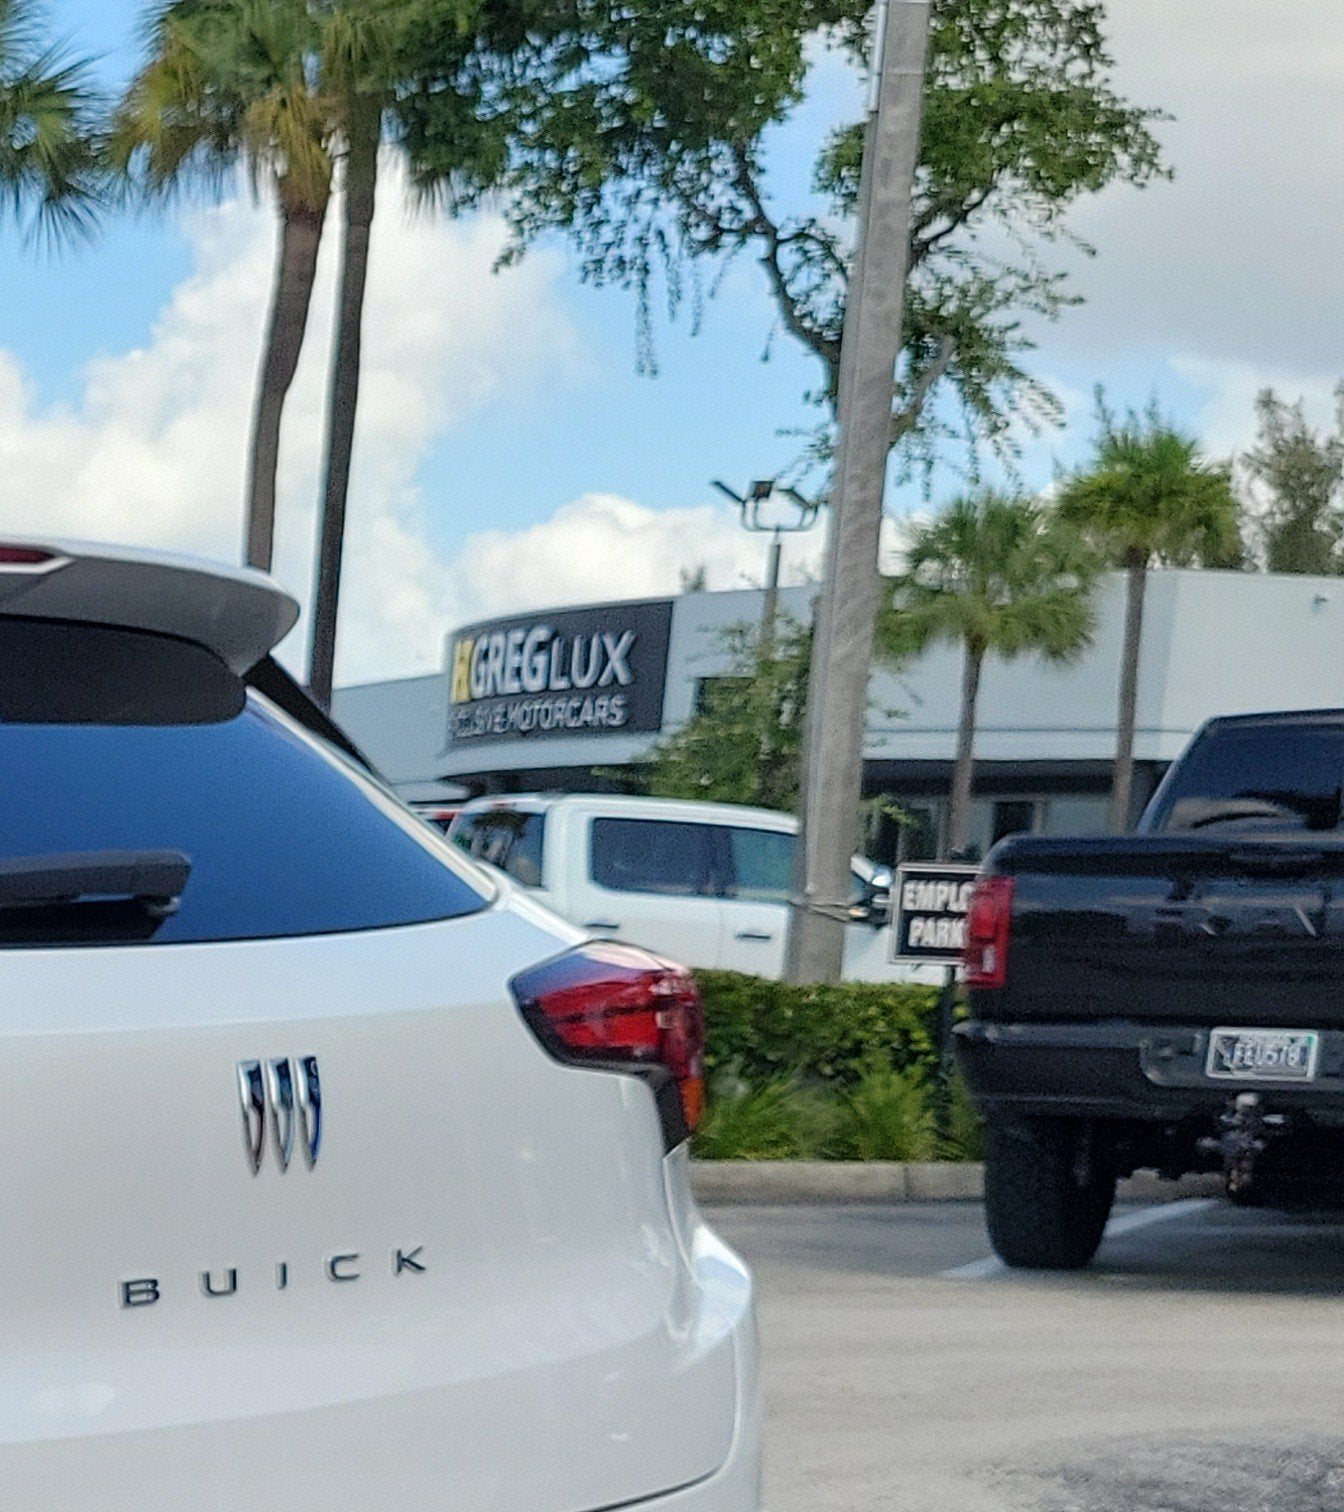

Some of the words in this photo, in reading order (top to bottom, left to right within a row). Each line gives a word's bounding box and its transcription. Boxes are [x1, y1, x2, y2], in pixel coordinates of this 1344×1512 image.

[902, 879, 973, 913] EMPLO
[907, 915, 968, 949] PARK
[121, 1245, 426, 1310] BUICK
